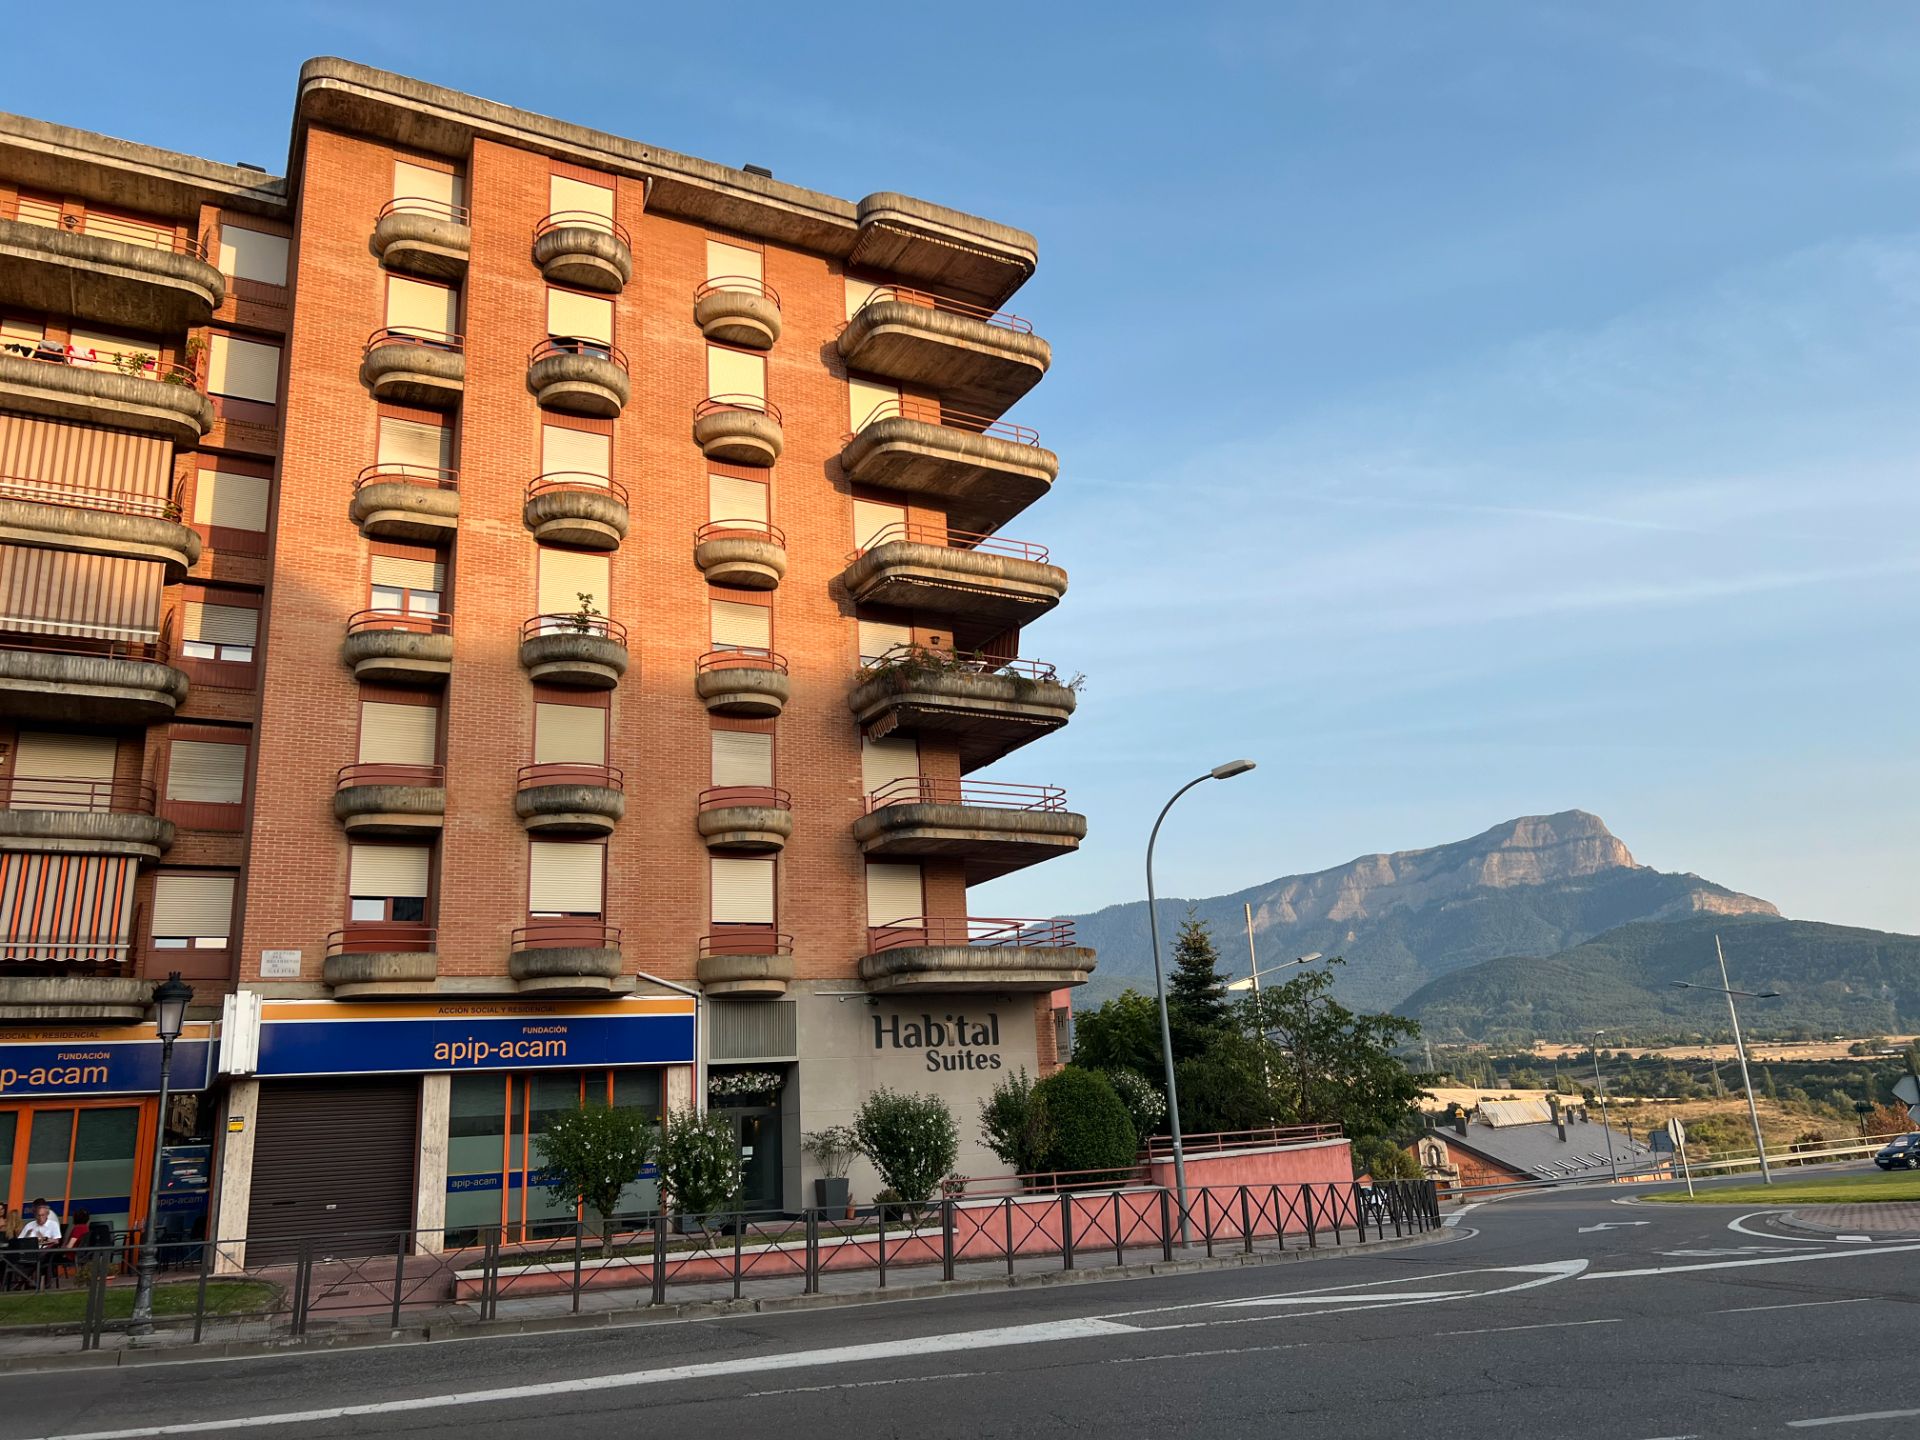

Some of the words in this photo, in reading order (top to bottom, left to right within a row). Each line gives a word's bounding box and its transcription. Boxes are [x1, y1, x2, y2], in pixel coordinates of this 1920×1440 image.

[470, 1006, 498, 1014] SOCIAL
[522, 1025, 568, 1034] FUNDACIÓN
[872, 1013, 1000, 1049] Habital
[41, 1031, 100, 1039] RESIDENCIAL
[57, 1051, 111, 1060] FUNDACIÓN
[434, 1036, 567, 1065] apip-acam
[926, 1049, 1002, 1072] Suites
[451, 1177, 497, 1189] apip-acam
